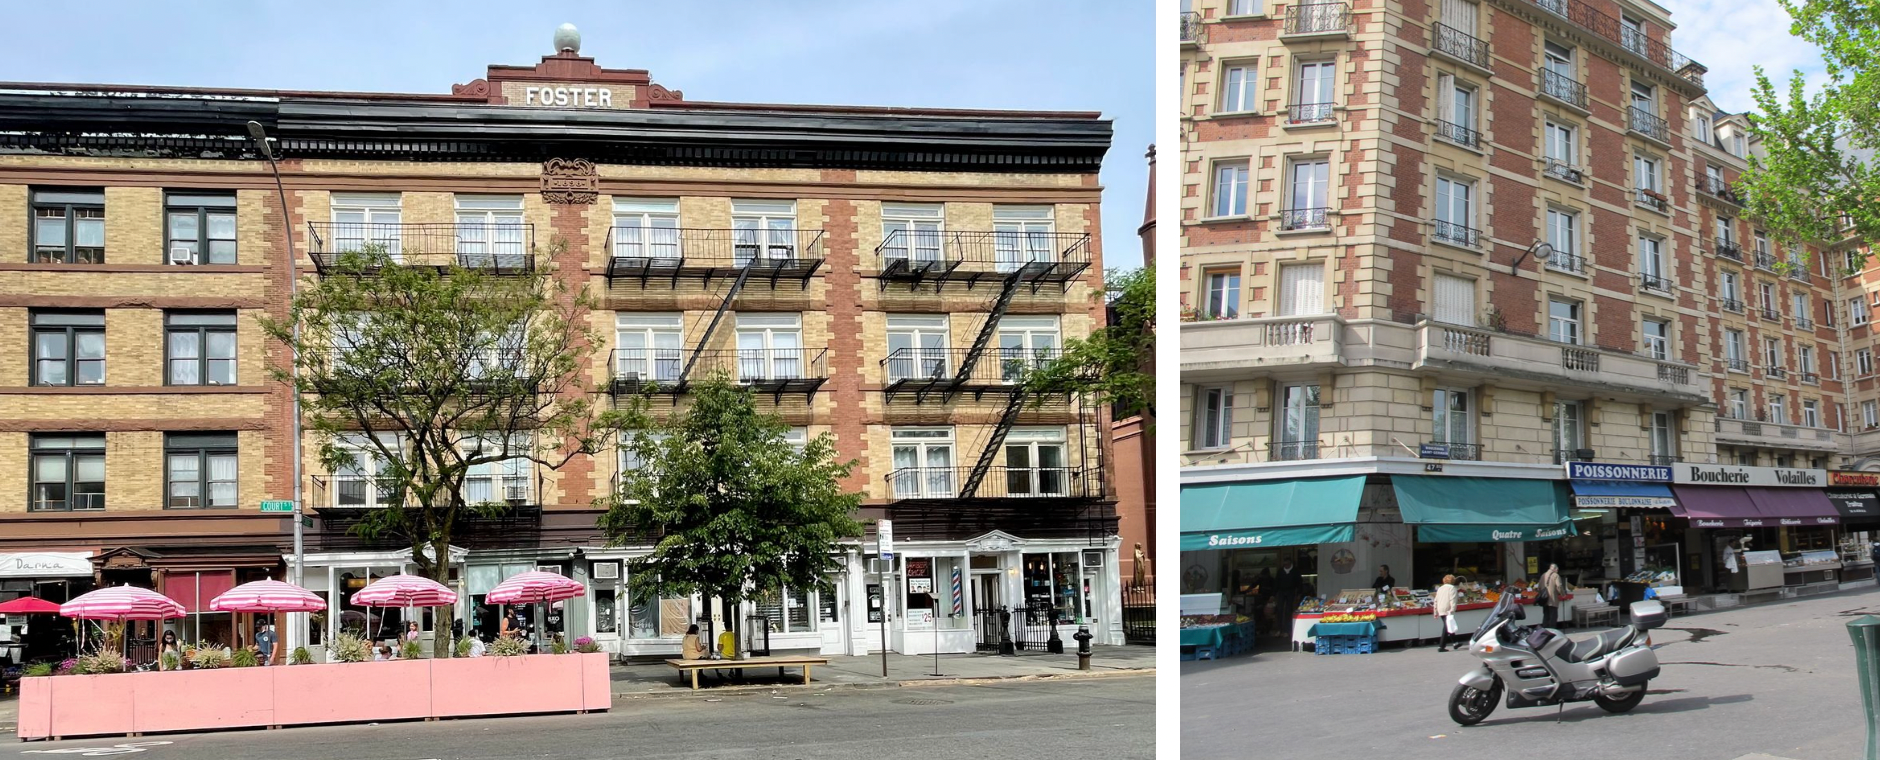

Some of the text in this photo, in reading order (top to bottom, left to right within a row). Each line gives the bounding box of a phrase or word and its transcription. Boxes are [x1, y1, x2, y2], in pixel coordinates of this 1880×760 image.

[526, 87, 612, 107] FOSTER
[1575, 464, 1669, 480] POISSONNERIE
[1690, 466, 1816, 485] Boucherie Volailles
[263, 502, 283, 511] COURT
[1577, 497, 1616, 506] POISSONNERIE
[1208, 534, 1262, 546] Saisons
[1492, 528, 1567, 541] Quatre Saisons
[16, 558, 65, 569] Darna
